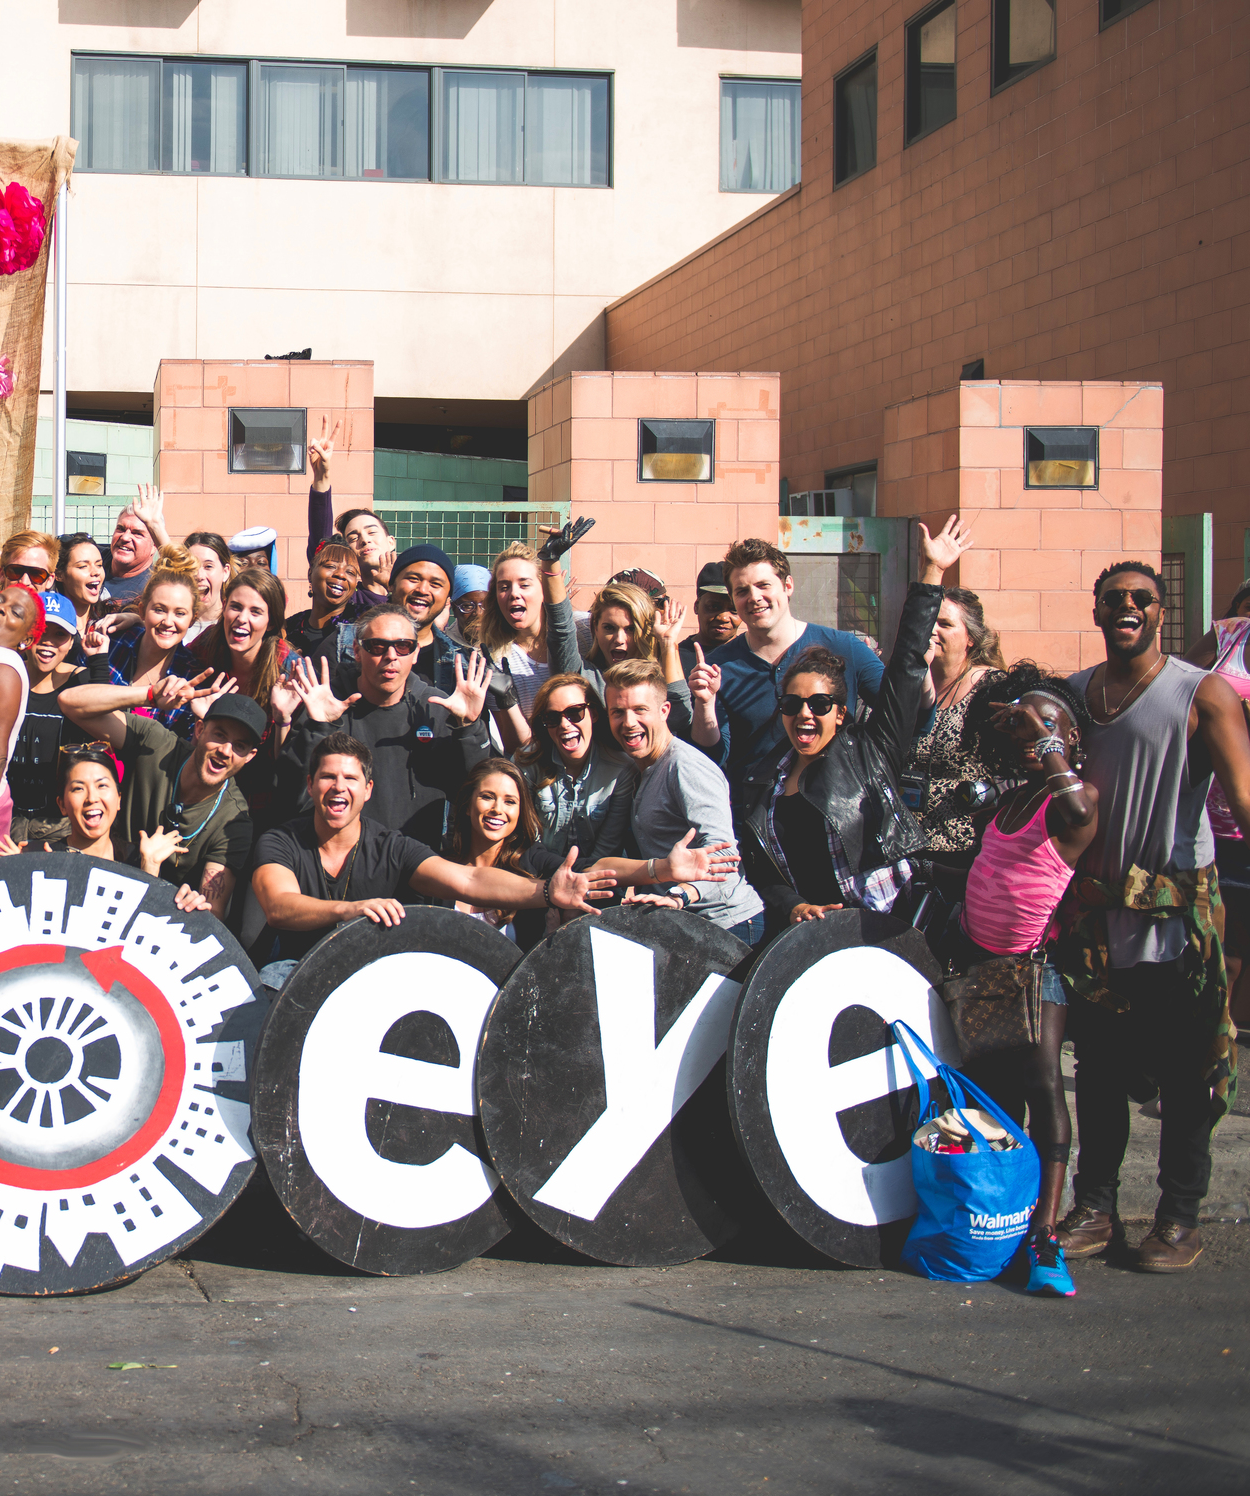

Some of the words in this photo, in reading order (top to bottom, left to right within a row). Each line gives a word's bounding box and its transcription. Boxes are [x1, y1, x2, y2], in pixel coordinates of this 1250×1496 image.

[45, 596, 60, 613] LA
[297, 924, 962, 1228] eye
[969, 1206, 1030, 1229] Walmart
[969, 1228, 985, 1236] Save
